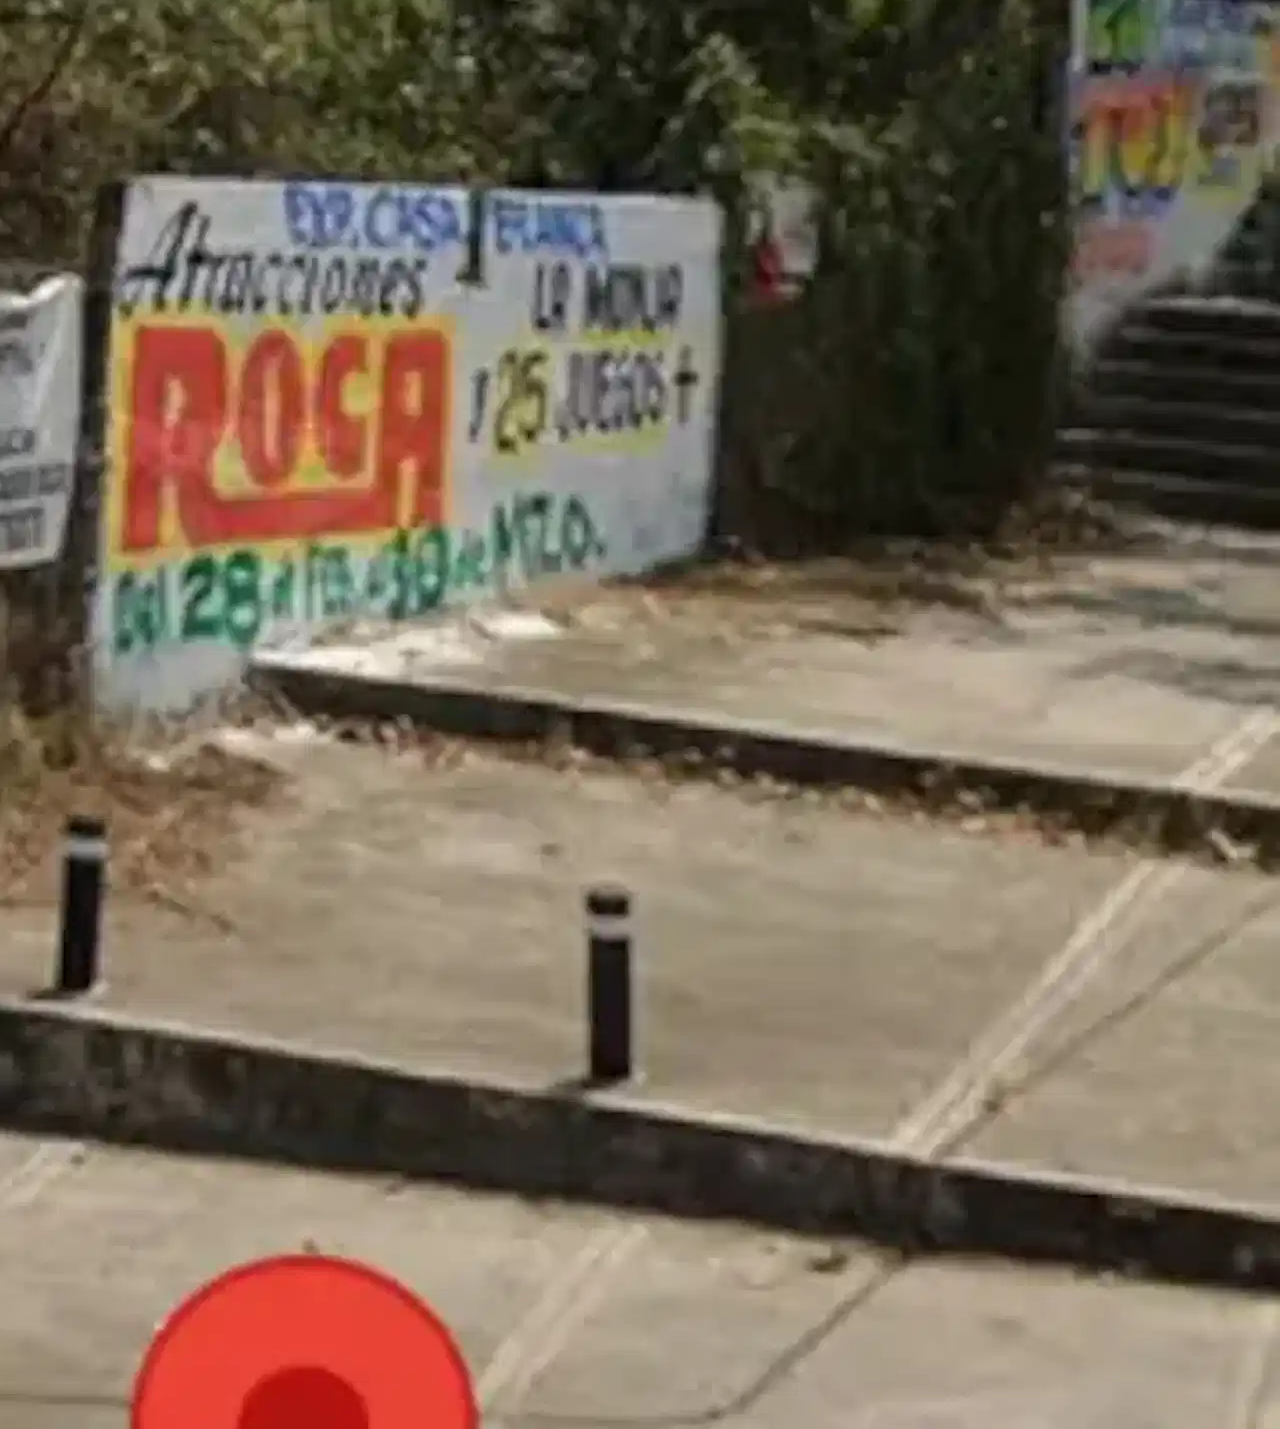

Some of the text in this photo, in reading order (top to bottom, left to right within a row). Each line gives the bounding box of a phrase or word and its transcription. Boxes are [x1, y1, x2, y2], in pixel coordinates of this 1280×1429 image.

[116, 200, 429, 319] Atracciones
[120, 324, 453, 556] ROCA
[494, 347, 550, 455] 25
[180, 548, 262, 645] 28
